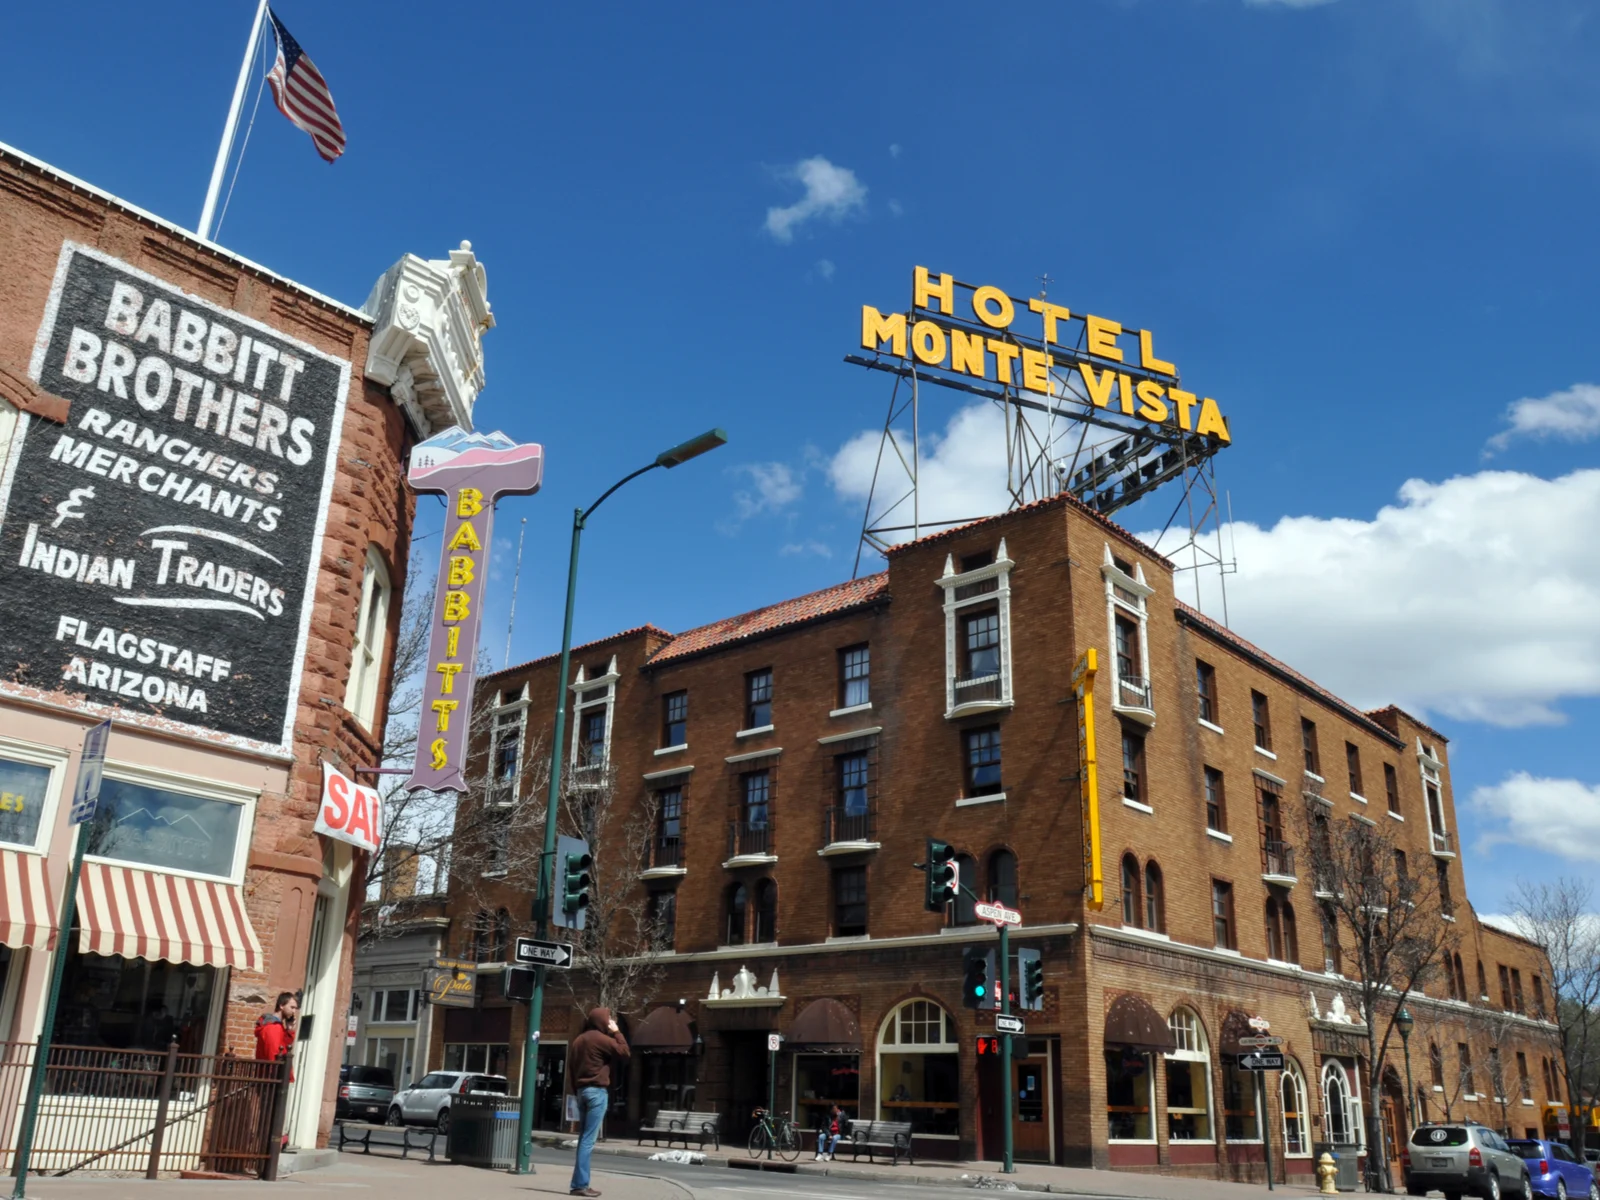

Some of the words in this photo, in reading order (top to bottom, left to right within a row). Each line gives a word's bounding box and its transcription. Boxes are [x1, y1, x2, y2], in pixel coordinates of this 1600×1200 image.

[104, 280, 304, 402] BABBITT
[913, 265, 1176, 377] HOTEL
[62, 326, 316, 467] BROTHERS
[861, 305, 1055, 395] MONTE
[1078, 362, 1231, 443] VISTA
[50, 434, 282, 532] MERCHANTS
[78, 408, 284, 500] RANCHERS,
[51, 486, 95, 528] &
[19, 523, 135, 589] INDIAN
[151, 539, 285, 617] TRADERS
[55, 615, 231, 683] FLAGSTAFF
[429, 488, 484, 771] BABBITTS
[62, 657, 208, 713] ARIZONA
[522, 946, 538, 957] ONE
[540, 948, 556, 958] WAY
[982, 906, 1001, 918] ASPEN
[1004, 911, 1016, 922] AVE
[999, 1019, 1008, 1027] ONE
[1008, 1020, 1016, 1028] WAY
[1252, 1058, 1265, 1066] ONE
[1266, 1058, 1280, 1066] WAY
